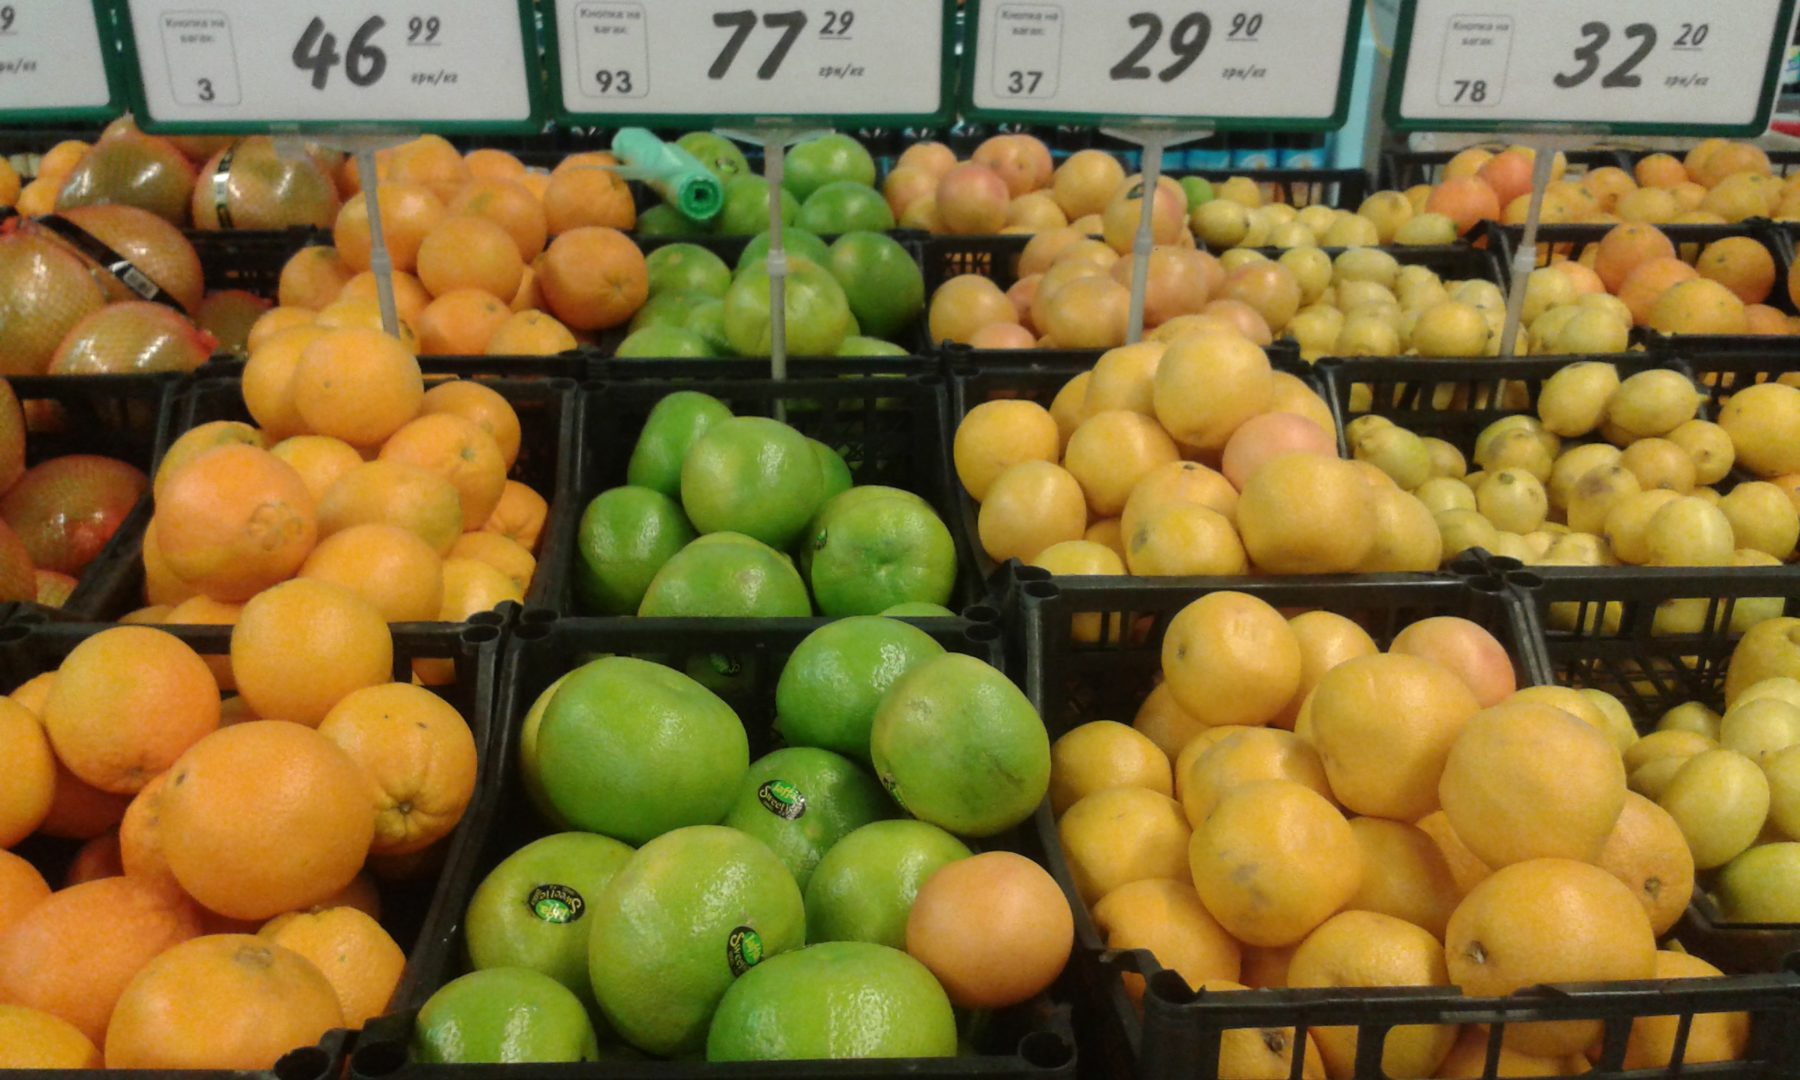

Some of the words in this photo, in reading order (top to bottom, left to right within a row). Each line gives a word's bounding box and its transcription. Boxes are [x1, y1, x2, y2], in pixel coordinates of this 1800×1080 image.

[408, 16, 440, 43] 99
[819, 10, 854, 36] 29
[1227, 13, 1263, 37] 90
[1673, 23, 1709, 46] 20
[292, 15, 387, 90] 46
[707, 9, 808, 80] 77
[1109, 12, 1212, 83] 29
[1553, 21, 1657, 89] 32
[197, 78, 215, 102] 3
[595, 70, 633, 94] 93
[1007, 71, 1043, 94] 37
[1454, 80, 1487, 103] 78
